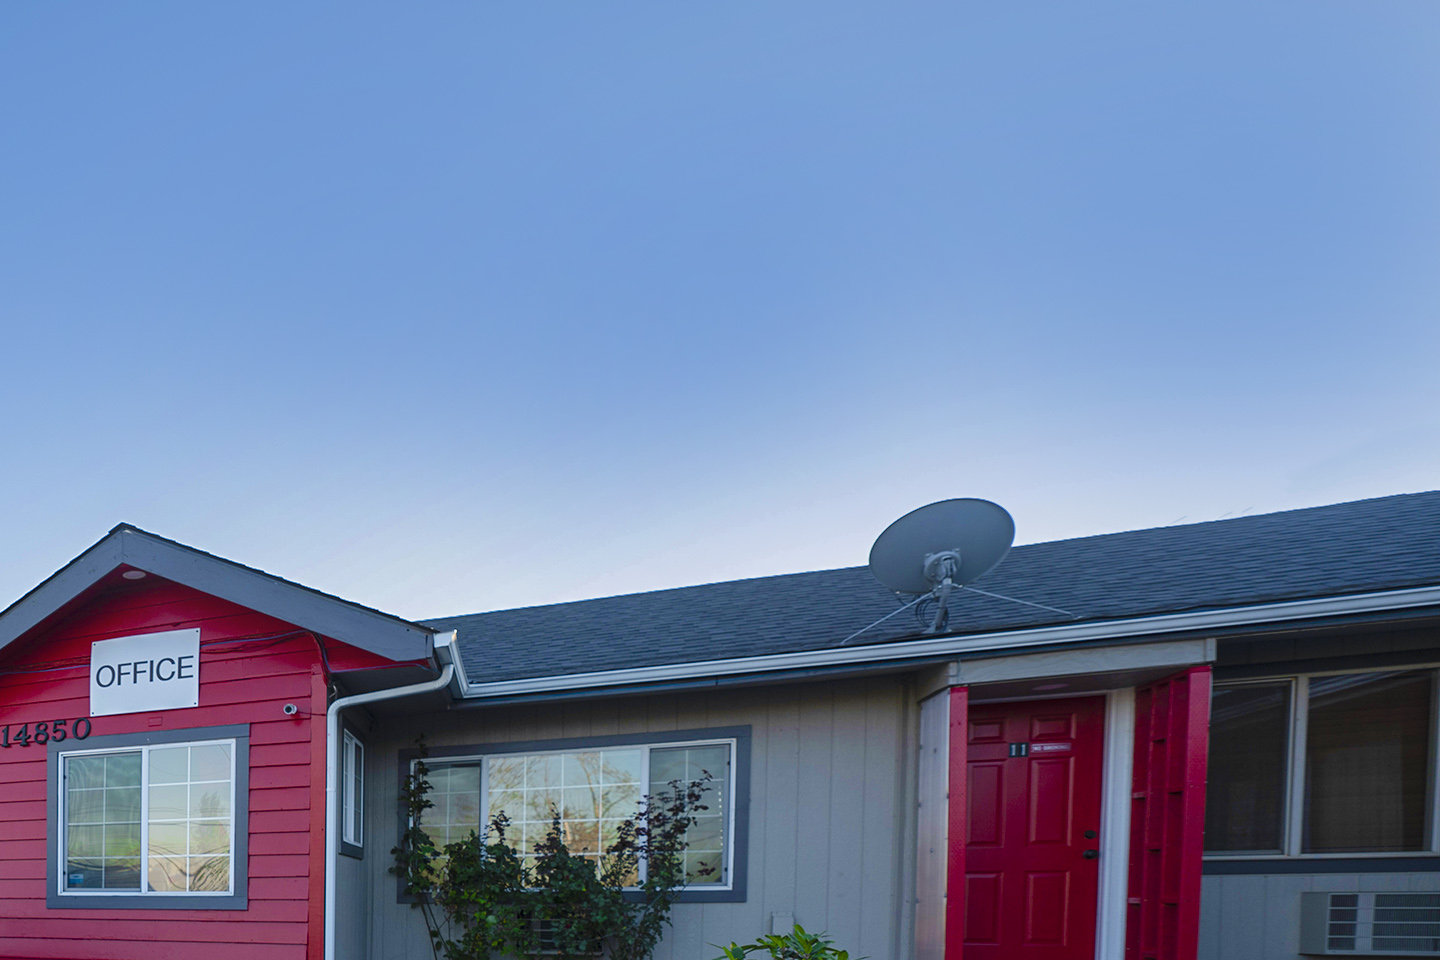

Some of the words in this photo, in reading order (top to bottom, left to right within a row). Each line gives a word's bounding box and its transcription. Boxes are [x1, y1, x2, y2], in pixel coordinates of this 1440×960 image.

[96, 655, 194, 688] OFFICE
[1, 717, 91, 748] 14850
[1011, 743, 1026, 756] 11
